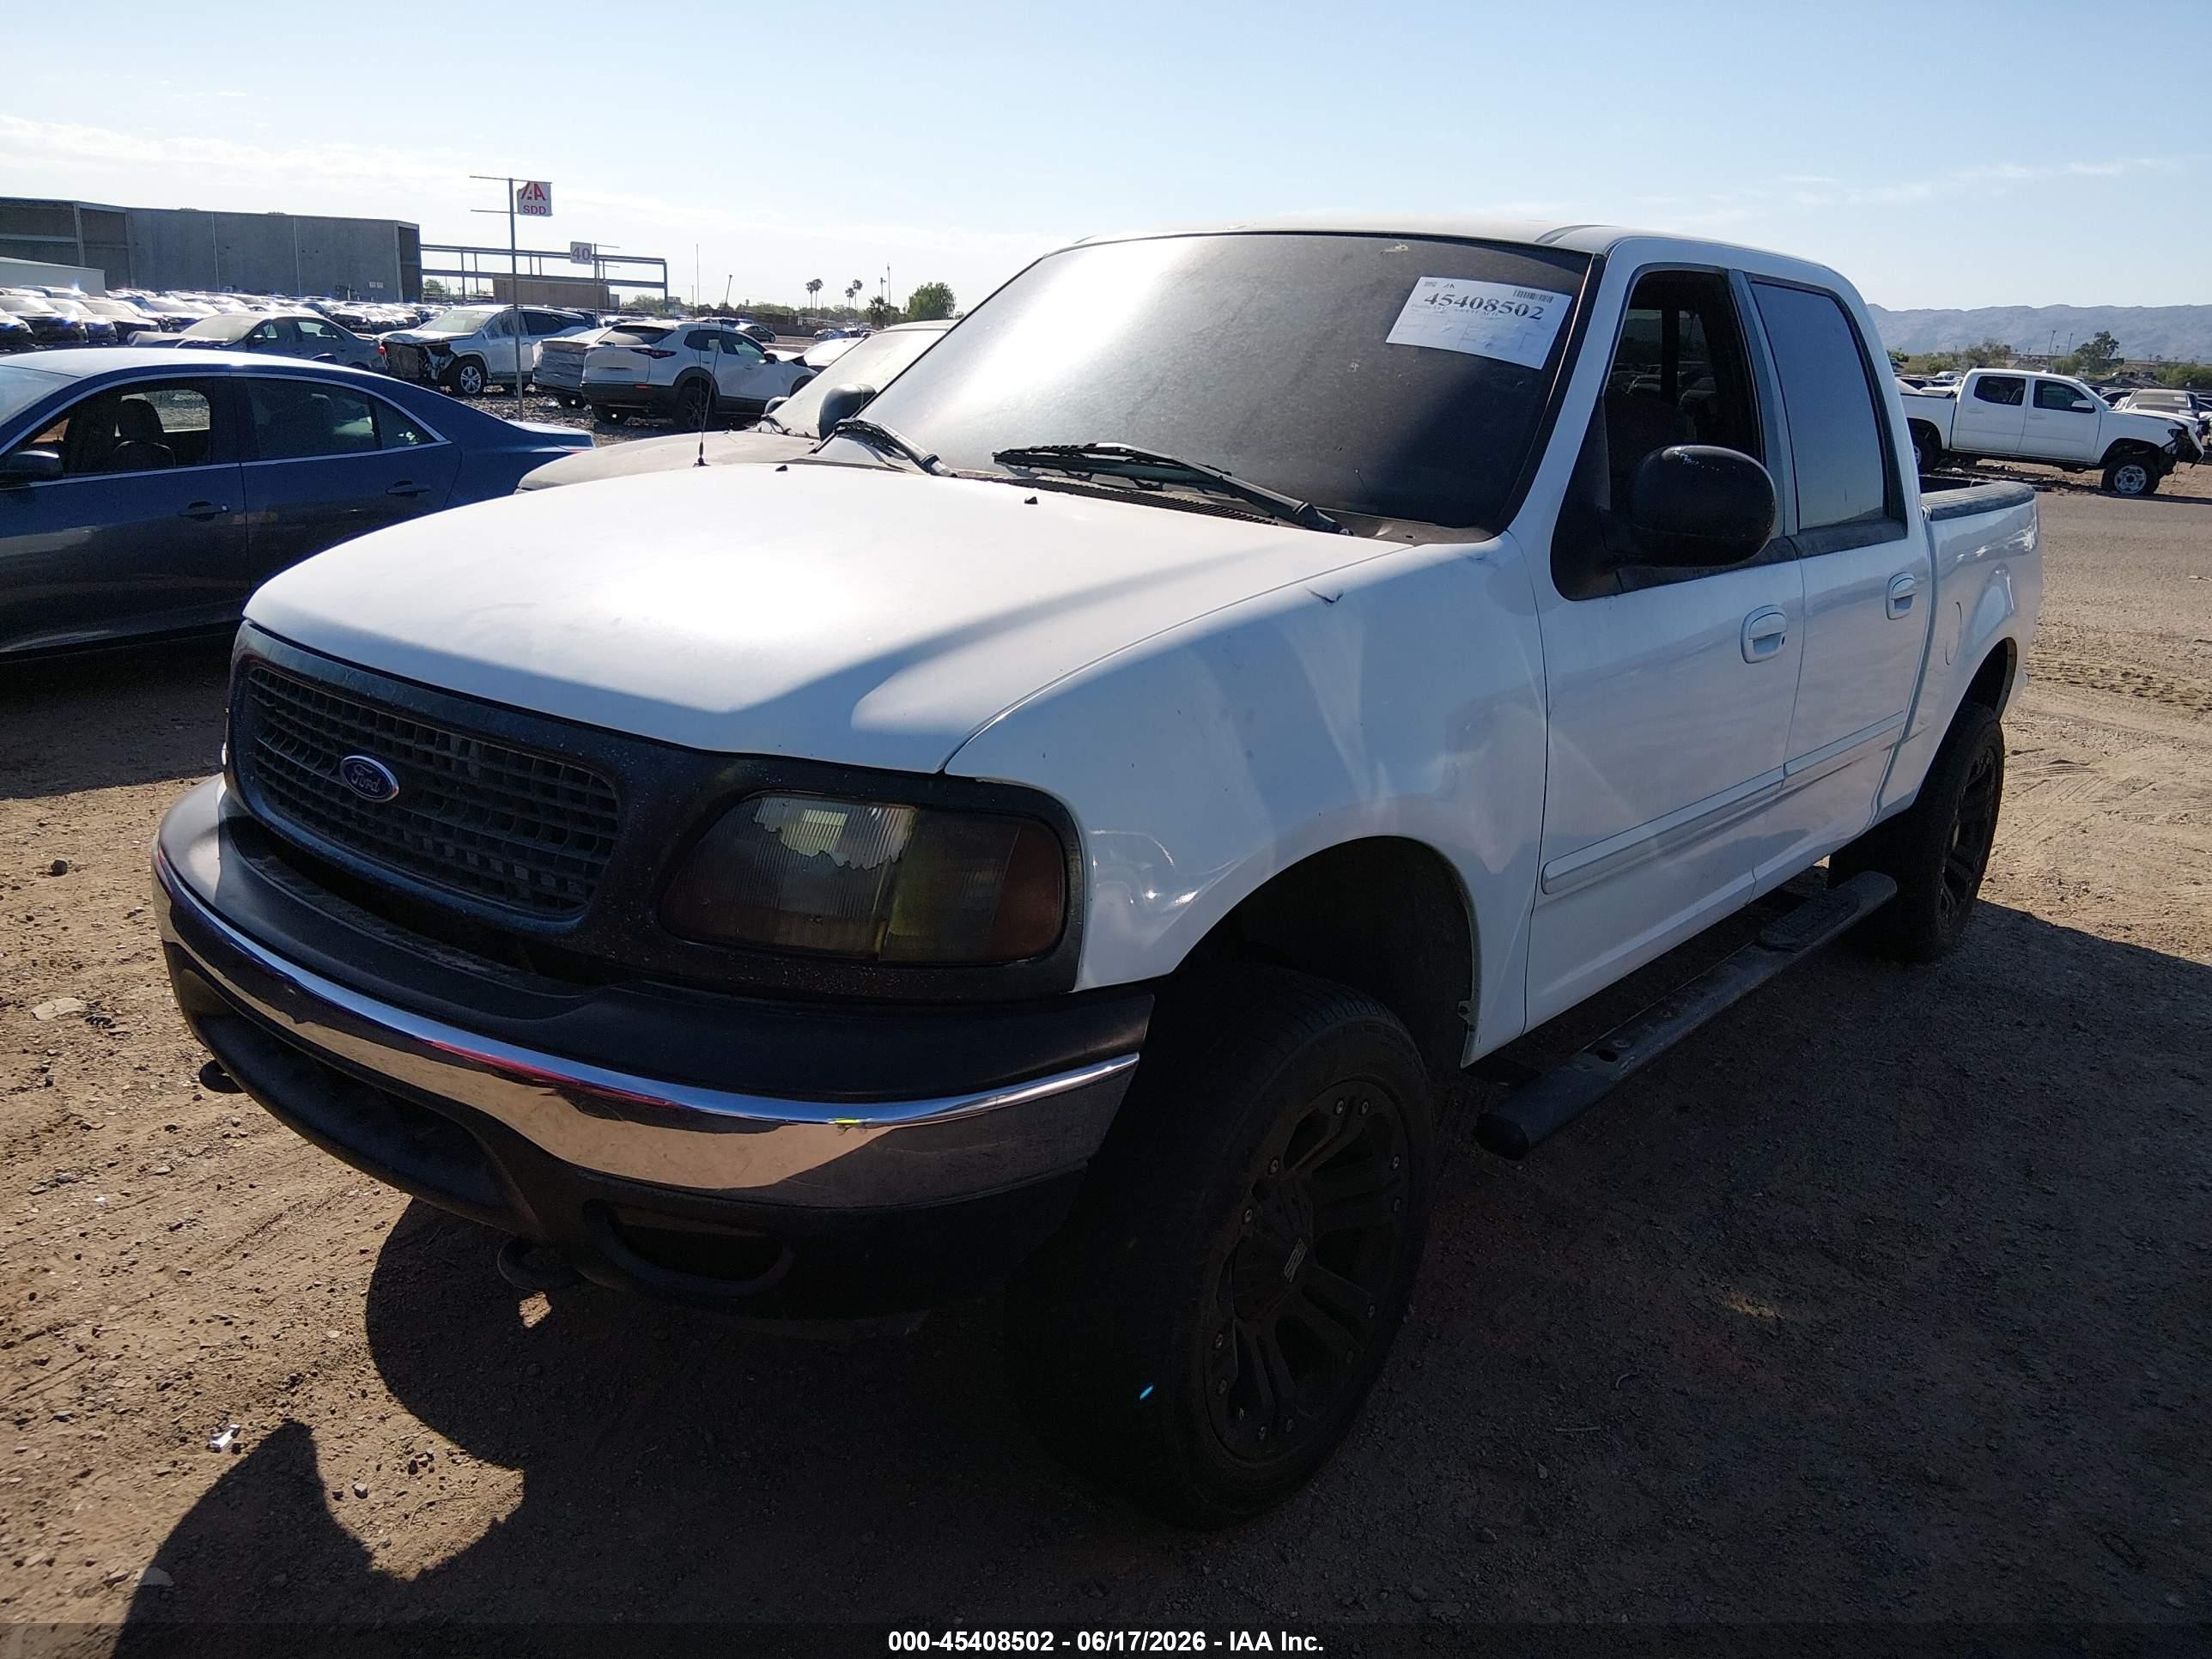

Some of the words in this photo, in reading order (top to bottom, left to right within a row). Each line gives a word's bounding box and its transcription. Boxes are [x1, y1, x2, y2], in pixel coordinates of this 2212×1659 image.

[523, 205, 546, 215] SDD
[571, 246, 591, 261] 40
[1424, 292, 1545, 320] 45408502
